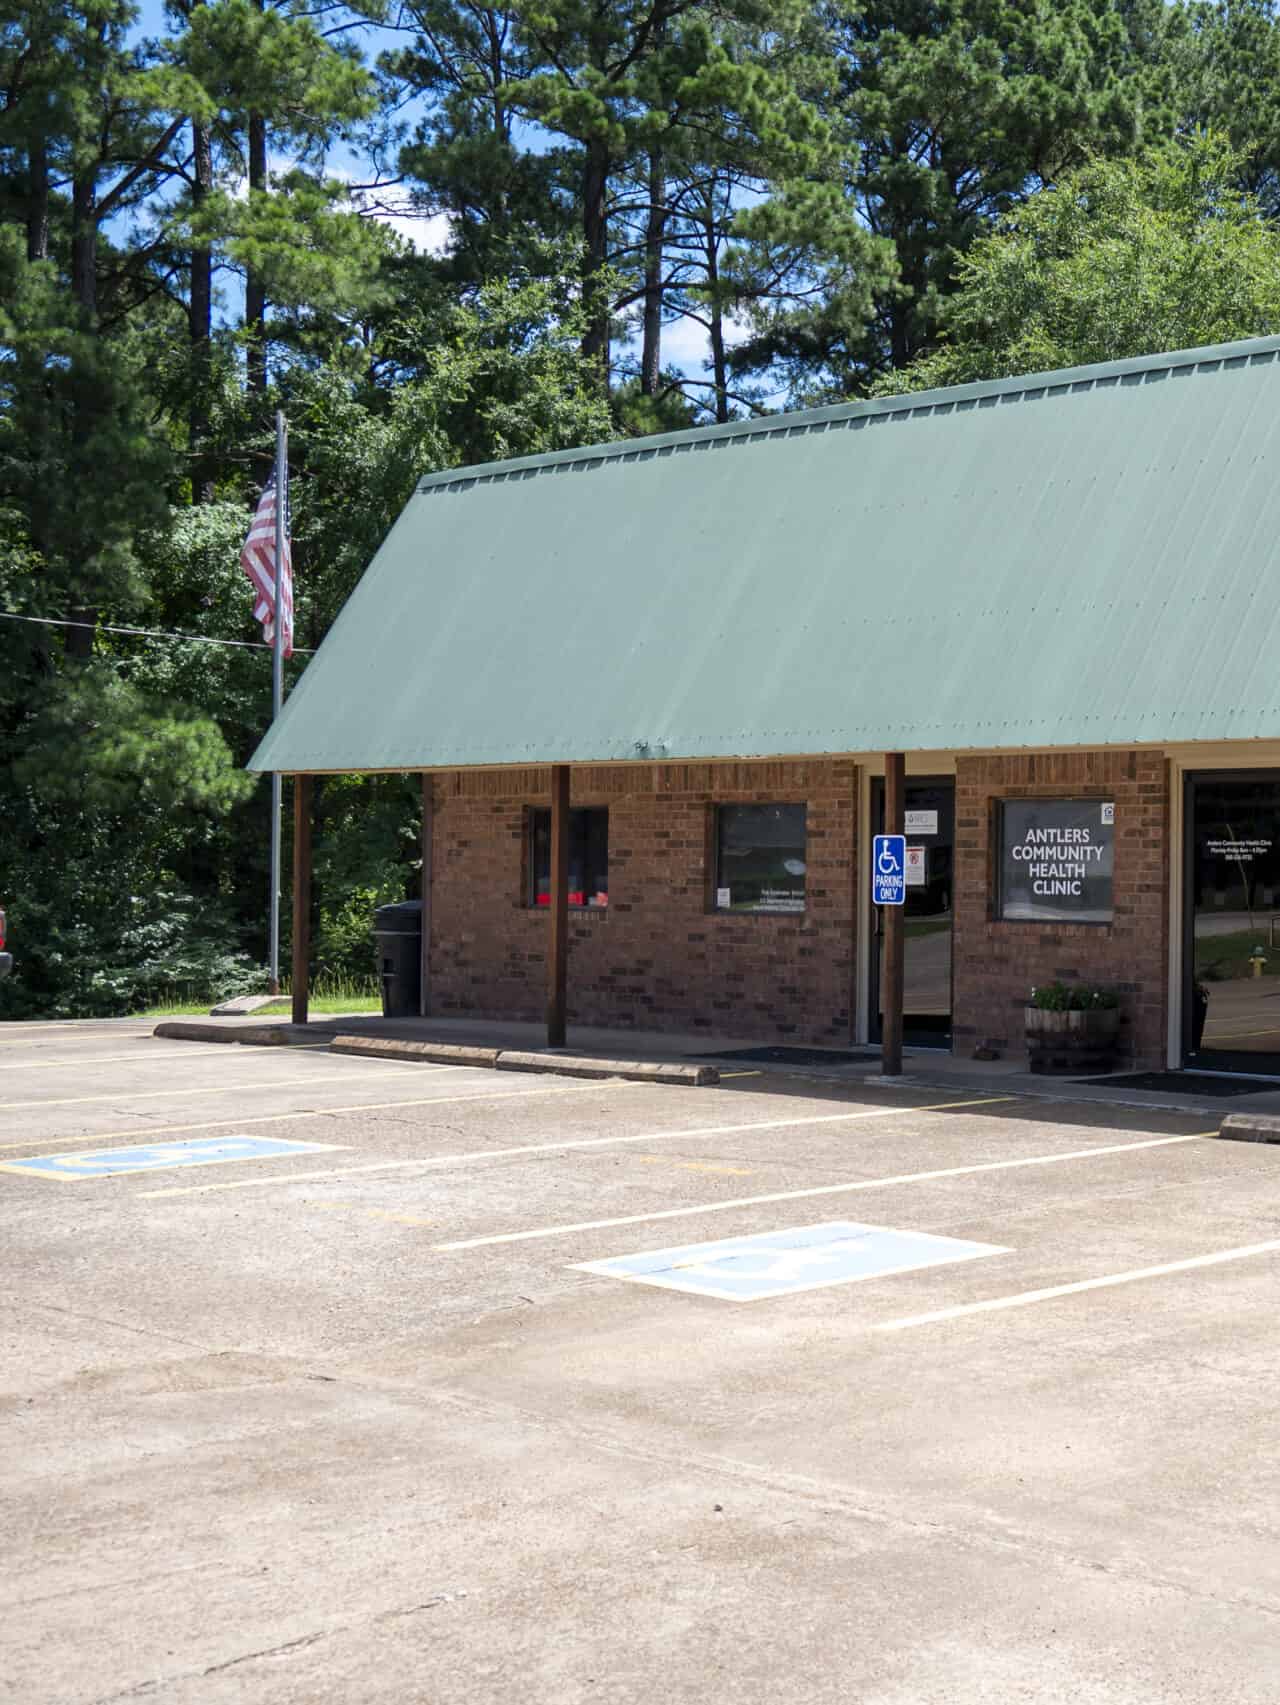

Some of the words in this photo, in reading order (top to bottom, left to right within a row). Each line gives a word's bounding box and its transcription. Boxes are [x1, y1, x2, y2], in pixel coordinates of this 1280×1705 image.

[1025, 828, 1090, 843] ANTLERS
[1012, 846, 1104, 861] COMMUNITY
[1029, 863, 1085, 878] HEALTH
[876, 874, 902, 888] PARKING
[1033, 881, 1081, 896] CLINIC
[880, 888, 898, 900] ONLY
